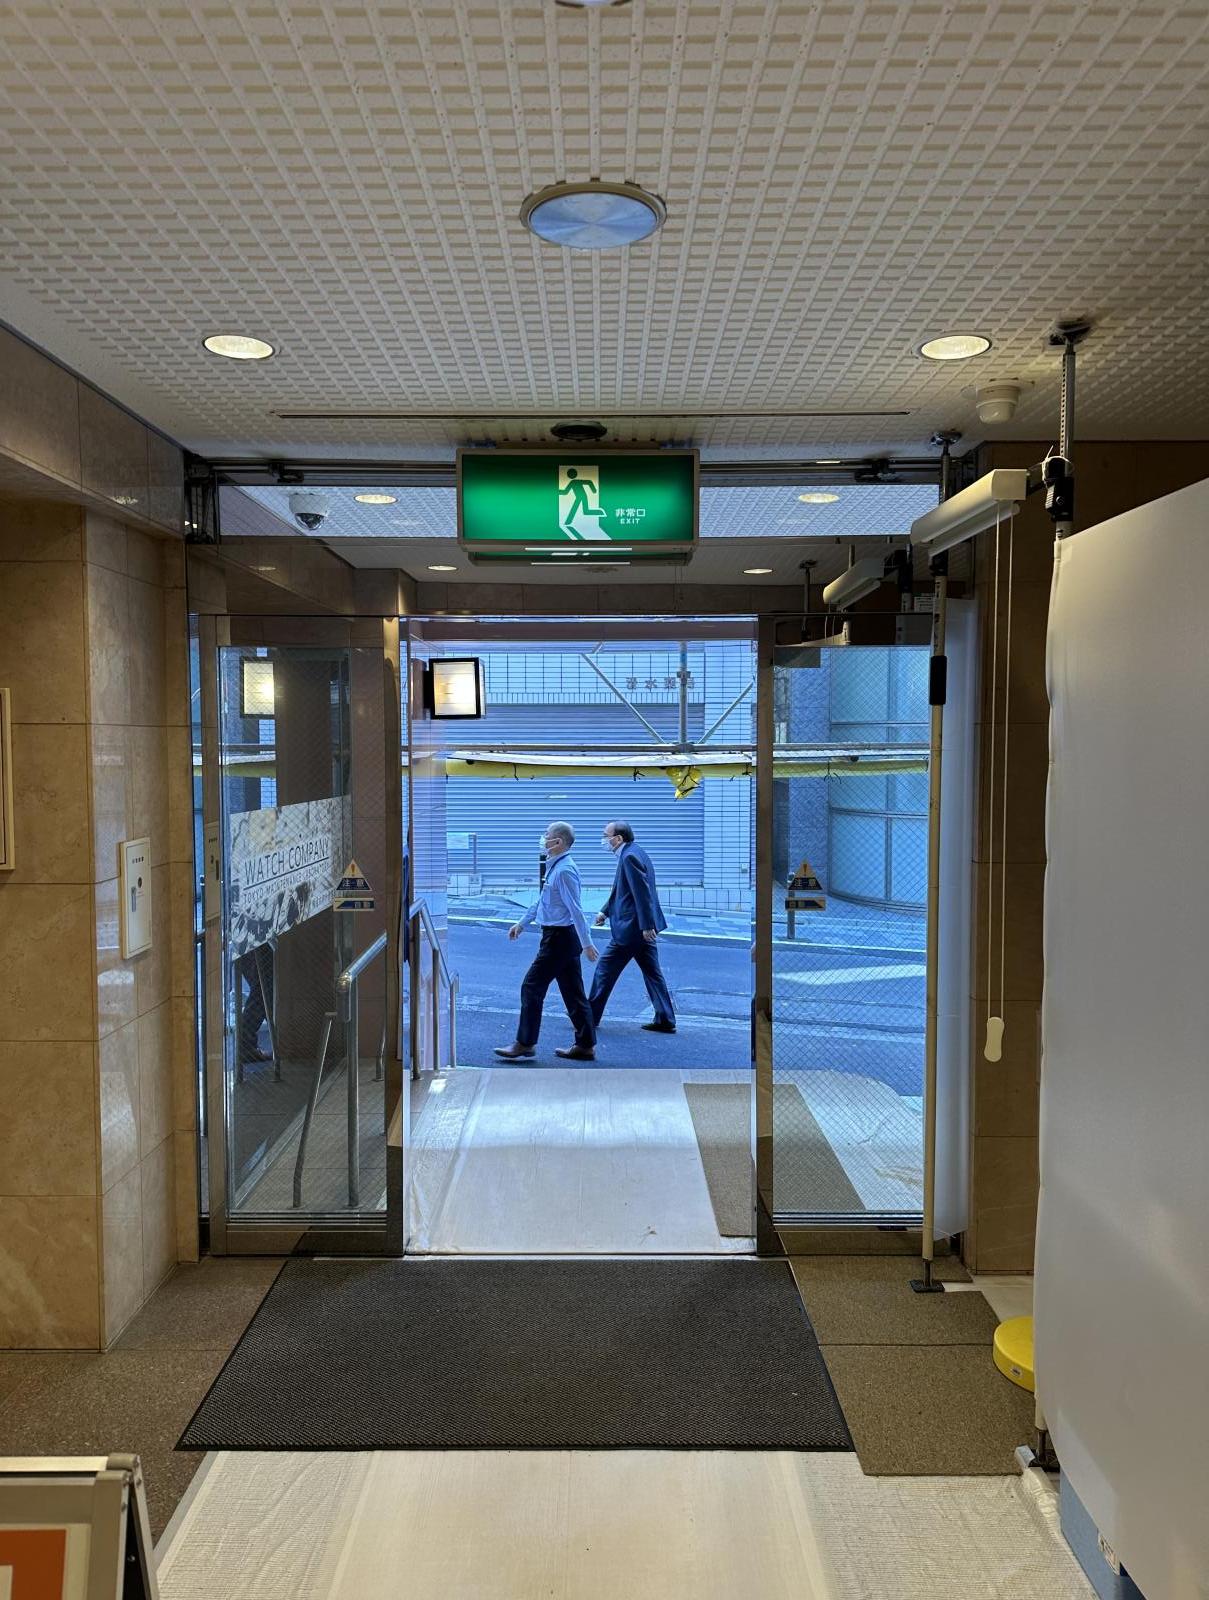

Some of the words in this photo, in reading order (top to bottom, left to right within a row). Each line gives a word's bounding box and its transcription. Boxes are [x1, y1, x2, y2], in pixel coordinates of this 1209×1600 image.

[615, 507, 646, 517] 非常口
[244, 851, 285, 886] WATCH
[288, 838, 329, 870] COMPANY
[243, 887, 264, 904] TOKYO
